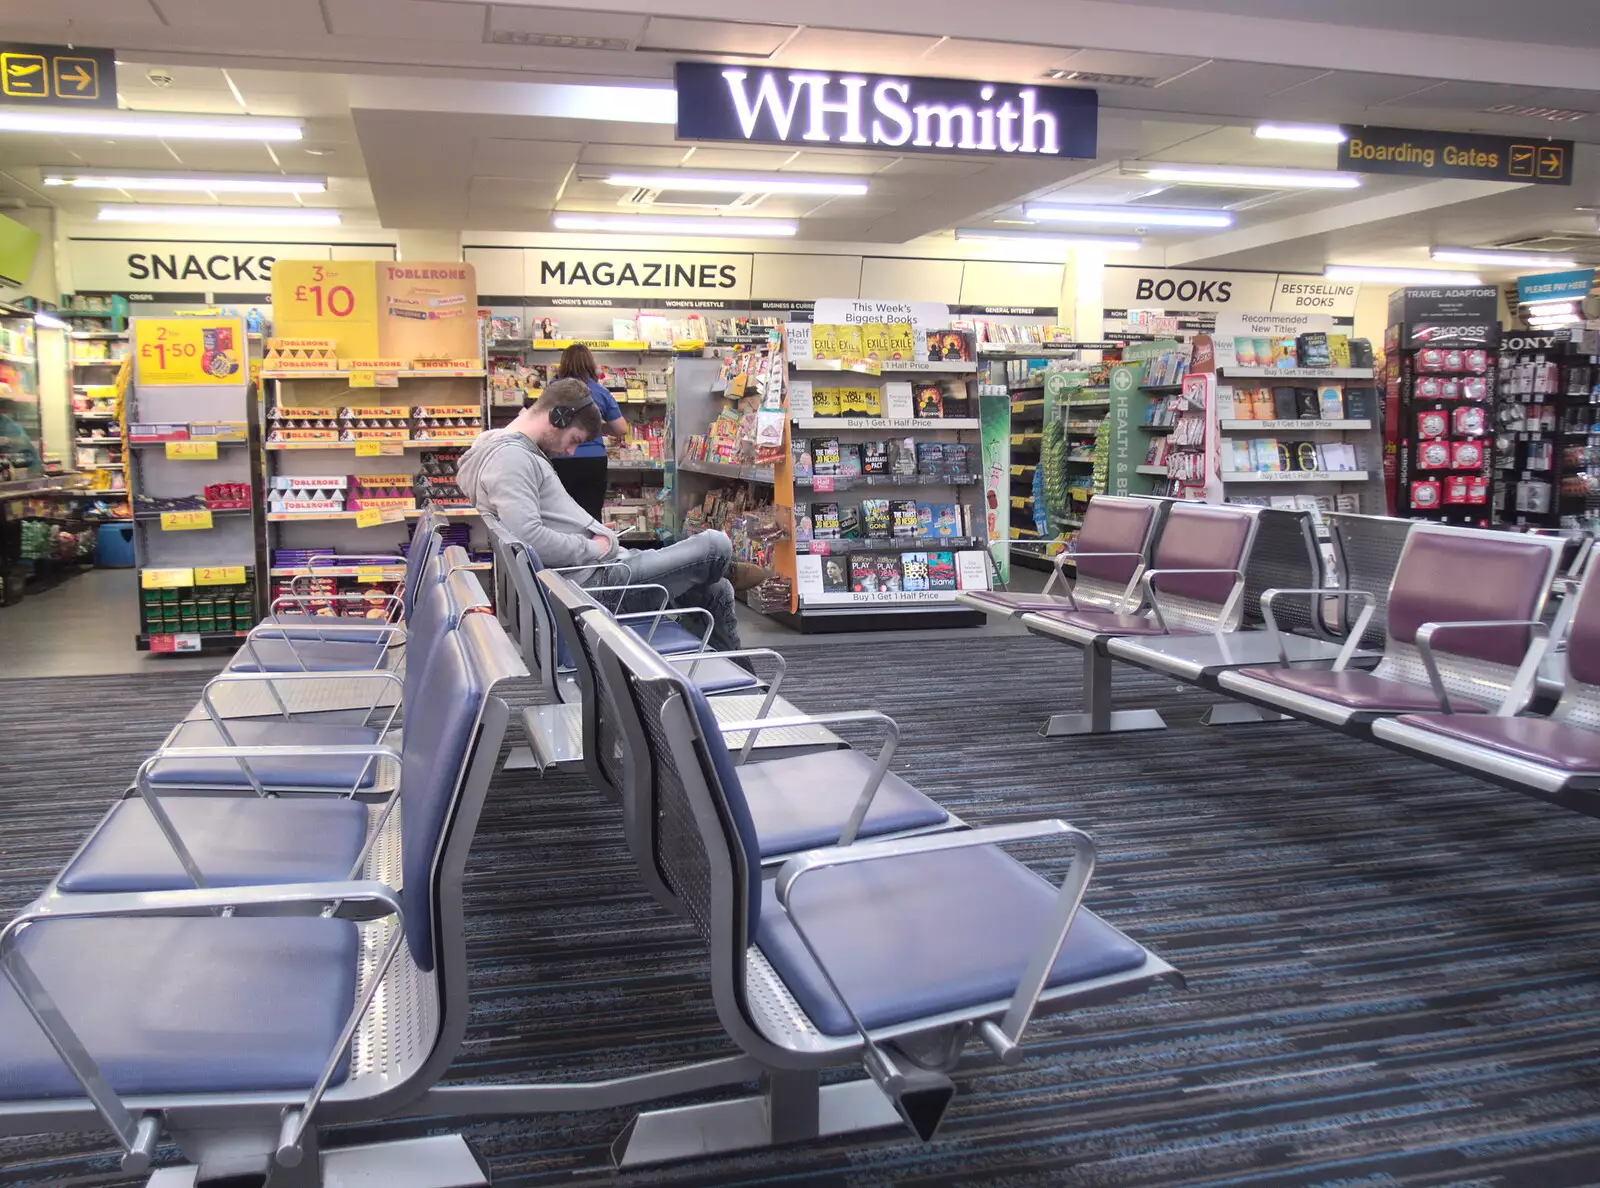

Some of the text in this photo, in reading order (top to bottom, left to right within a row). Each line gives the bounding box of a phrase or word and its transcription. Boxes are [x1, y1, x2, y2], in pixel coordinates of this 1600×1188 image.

[721, 71, 1059, 155] WHSmith
[1350, 139, 1498, 168] Boarding Gates
[128, 254, 276, 281] SNACKS
[312, 265, 324, 281] 3
[388, 267, 466, 280] TOBLERONE
[541, 261, 736, 288] MAGAZINES
[1135, 278, 1232, 303] BOOKS
[1281, 284, 1354, 296] BESTSELLING
[1524, 280, 1588, 294] PLEASE PAY HERE
[1407, 289, 1497, 298] TRAVEL ADAPTORS
[295, 285, 355, 317] £10
[1296, 296, 1335, 307] BOOKS
[852, 302, 911, 313] This Week's
[846, 313, 918, 325] Biggest Books
[1241, 314, 1308, 324] Recommended
[157, 327, 166, 341] 2
[787, 328, 810, 338] Half
[1251, 325, 1297, 333] New Titles
[814, 340, 836, 349] EXILE
[867, 339, 888, 349] EXILE
[890, 338, 912, 349] EXILE
[1215, 340, 1233, 349] New
[1499, 336, 1555, 350] SONY
[910, 362, 929, 370] Price
[912, 419, 932, 427] Price
[1117, 397, 1128, 458] HEALTH
[816, 455, 840, 463] JO NESBO
[872, 462, 883, 470] PACT
[1116, 463, 1128, 472] &
[358, 477, 407, 485] TOBLERONE
[823, 520, 839, 528] NESBO
[894, 517, 918, 525] JO NESBO
[904, 562, 928, 571] Black
[904, 570, 928, 579] Book
[931, 578, 954, 586] blame
[853, 594, 868, 602] Buy
